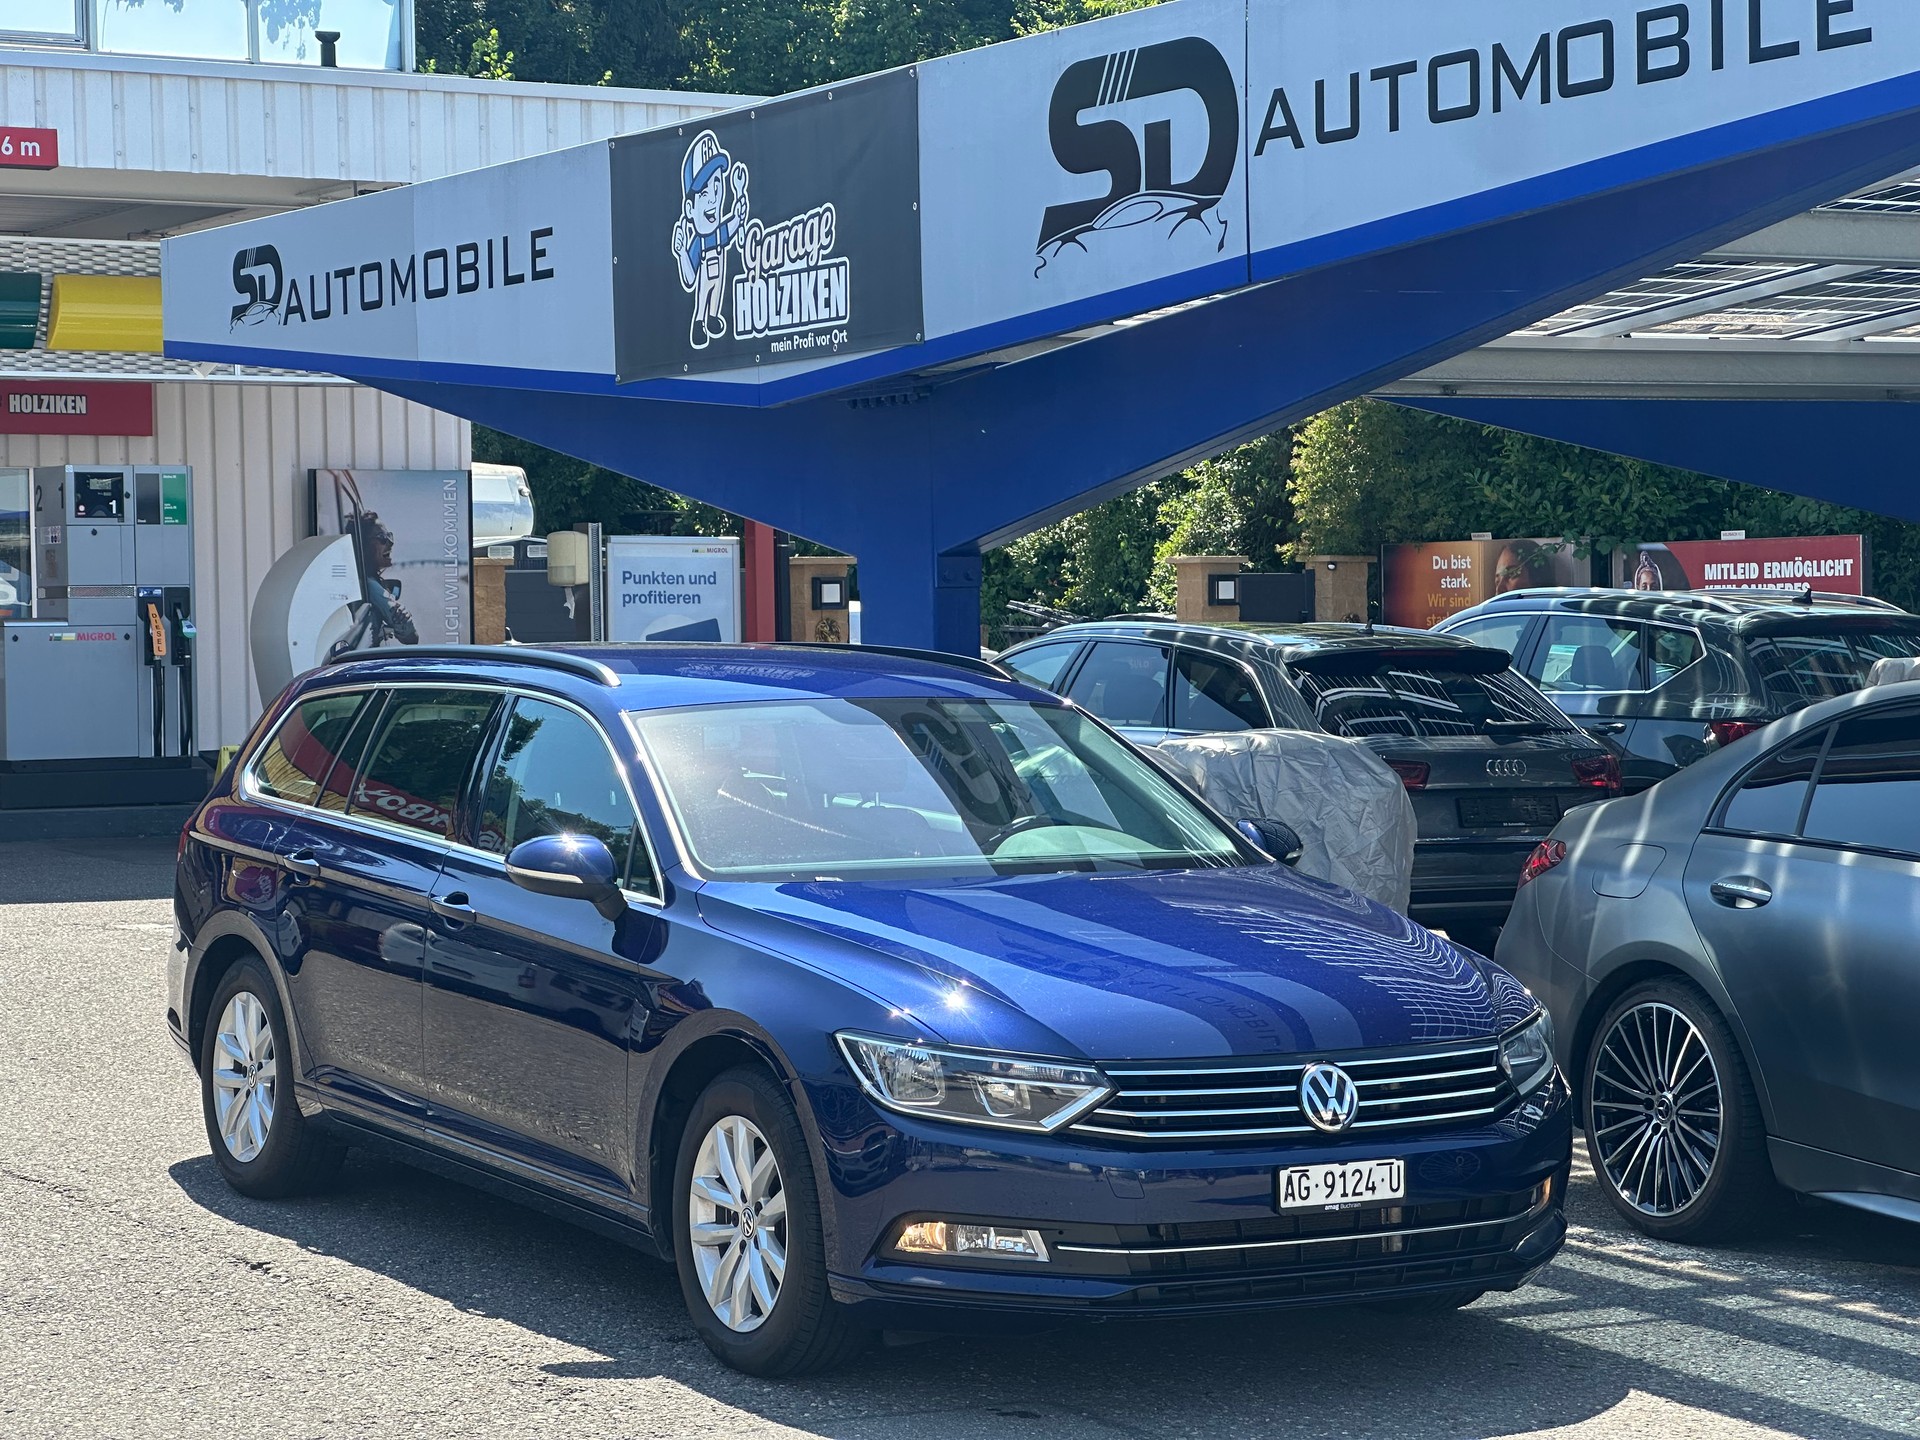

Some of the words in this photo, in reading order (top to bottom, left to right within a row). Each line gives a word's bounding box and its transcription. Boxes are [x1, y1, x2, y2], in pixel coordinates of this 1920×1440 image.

[1253, 0, 1872, 156] AUTOMOBILE
[20, 141, 40, 157] m
[745, 211, 832, 286] Garage
[283, 226, 554, 325] AUTOMOBILE
[736, 266, 846, 332] HOLZIKEN
[771, 337, 792, 352] mein
[793, 331, 815, 349] Profi
[815, 334, 830, 346] vor
[831, 329, 848, 344] Ort
[9, 394, 87, 414] HOLZIKEN
[109, 499, 117, 514] 1
[443, 479, 459, 598] WILLKOMMEN
[1432, 555, 1448, 570] Du
[1450, 554, 1472, 570] bist
[1704, 562, 1759, 580] MITLEID
[1763, 557, 1854, 579] ERMÖGLICHT
[622, 570, 685, 585] Punkten
[688, 571, 717, 585] und
[1440, 573, 1472, 589] stark.
[622, 590, 701, 607] profitieren
[1427, 593, 1447, 608] Wir
[1449, 592, 1472, 608] sind
[76, 632, 117, 641] MIGROL
[151, 612, 163, 652] DIESEL
